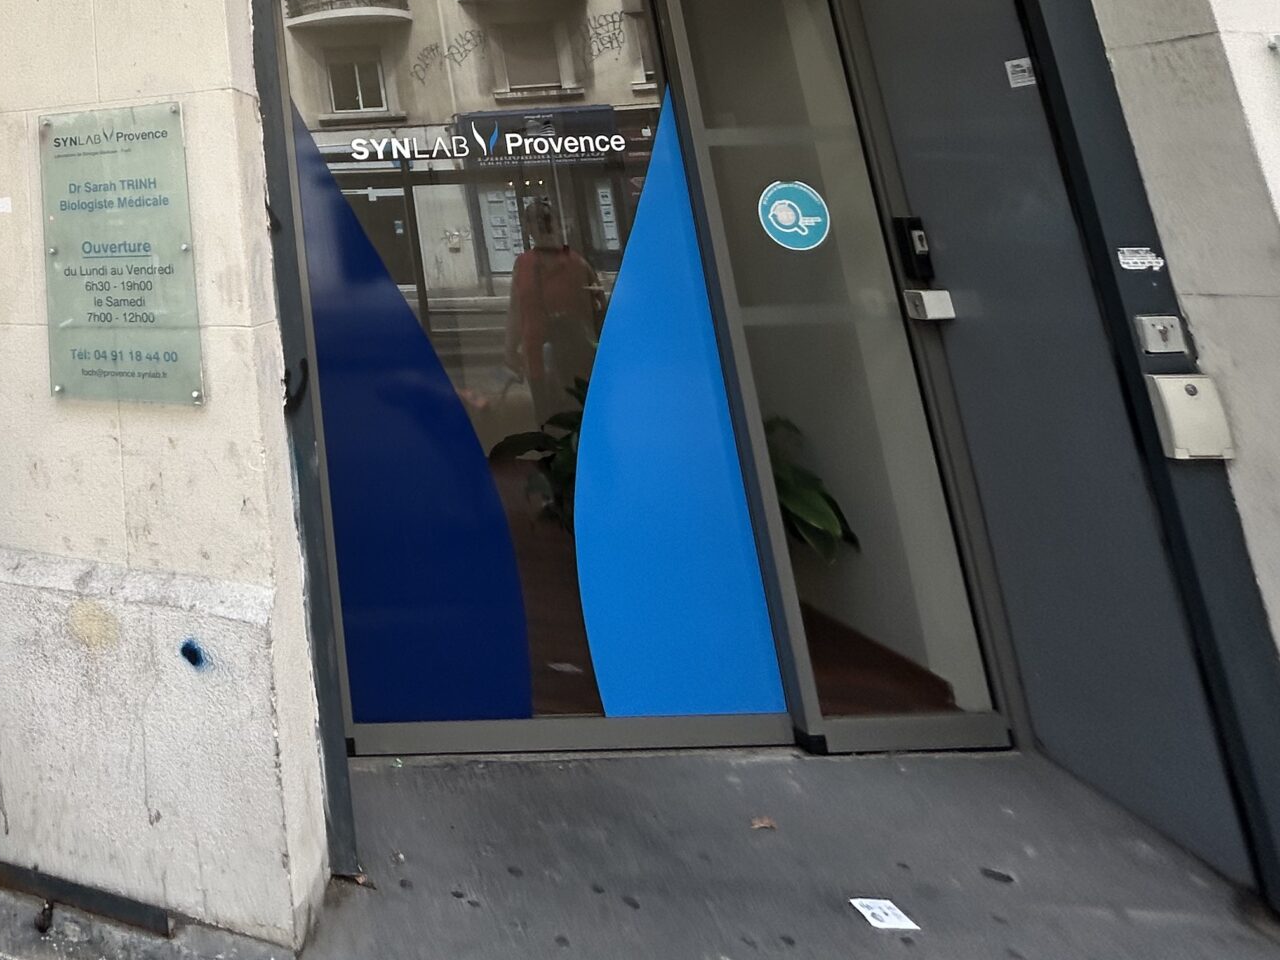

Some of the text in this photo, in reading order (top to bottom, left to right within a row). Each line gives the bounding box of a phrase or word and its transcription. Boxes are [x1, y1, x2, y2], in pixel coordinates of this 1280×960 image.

[53, 129, 168, 148] SYNLAB Provence
[351, 133, 469, 160] SYNLAB
[505, 133, 626, 156] Provence
[69, 178, 157, 194] Dr Sarah TRINH
[60, 195, 170, 212] Biologiste Médicale
[82, 240, 152, 256] Ouverture
[64, 264, 174, 277] du Lundi au Vendredi
[85, 281, 111, 292] 6h30
[121, 280, 153, 292] 19h00
[93, 295, 146, 308] le Samedi
[87, 312, 113, 323] 7h00
[123, 312, 155, 324] 12h00
[94, 349, 108, 361] 04
[111, 350, 123, 361] 91
[129, 350, 142, 362] 18
[145, 351, 160, 362] 44
[163, 351, 178, 362] 00
